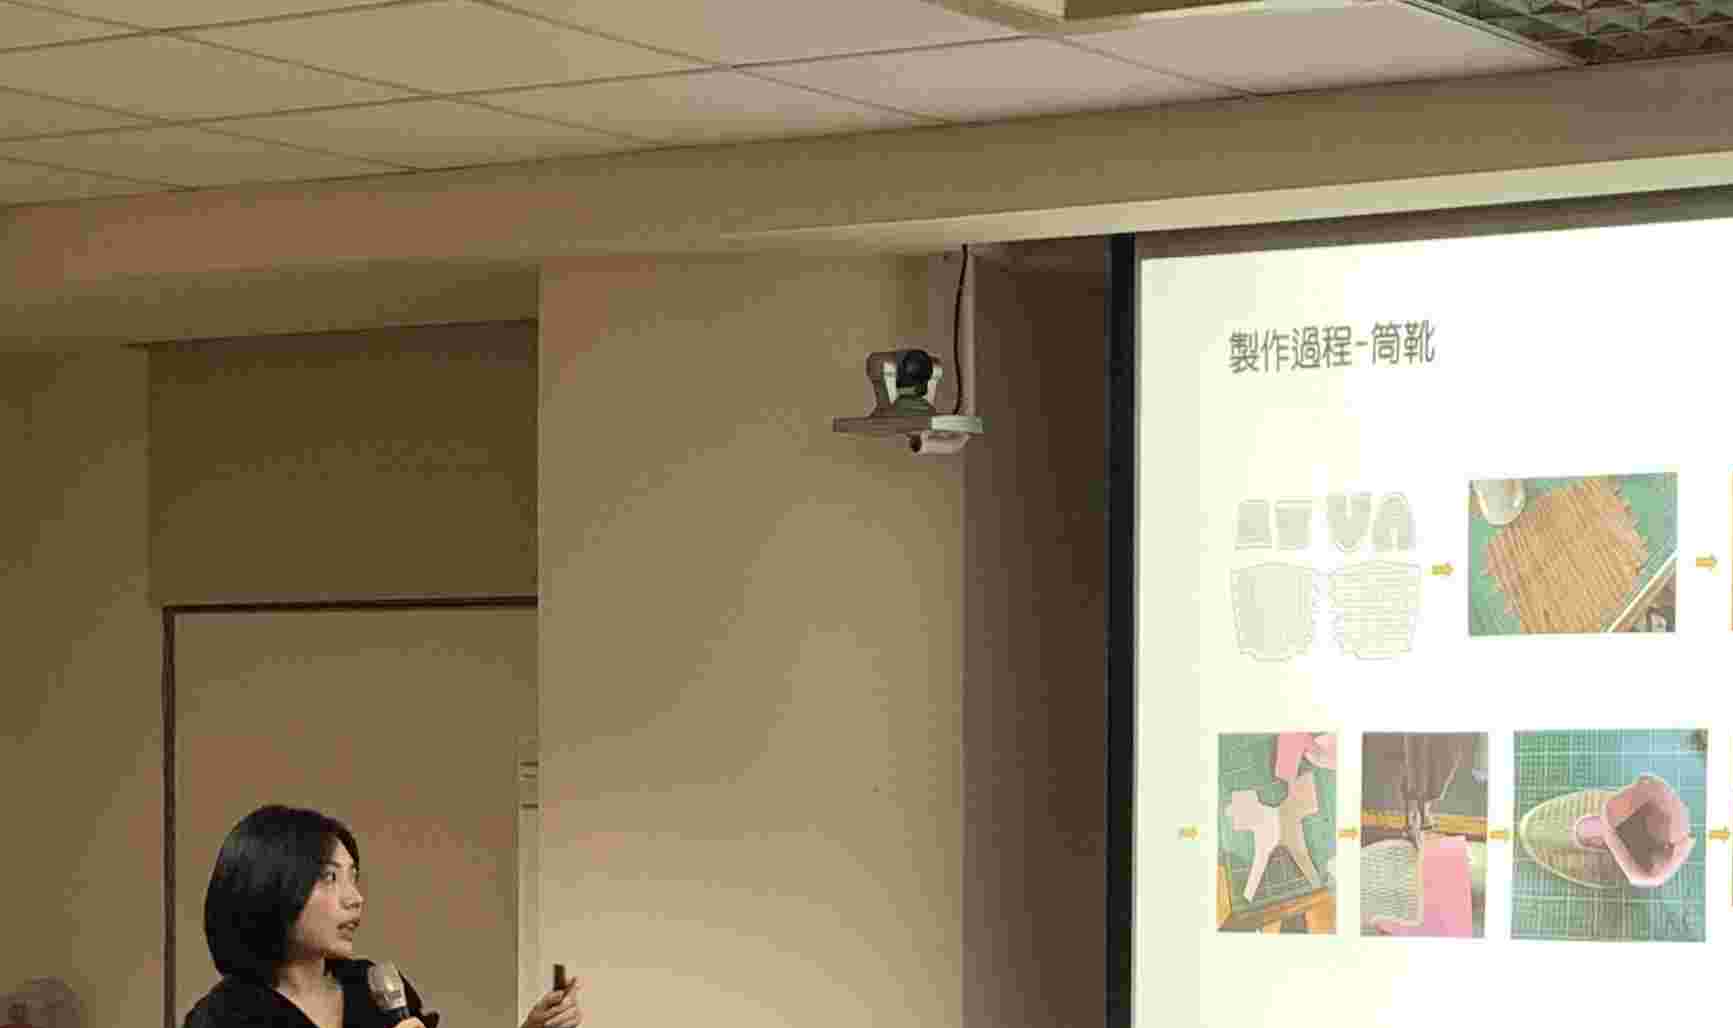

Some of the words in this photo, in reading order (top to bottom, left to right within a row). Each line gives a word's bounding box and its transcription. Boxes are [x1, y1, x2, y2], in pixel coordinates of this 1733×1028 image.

[1228, 319, 1435, 374] 製作過程-筒靴
